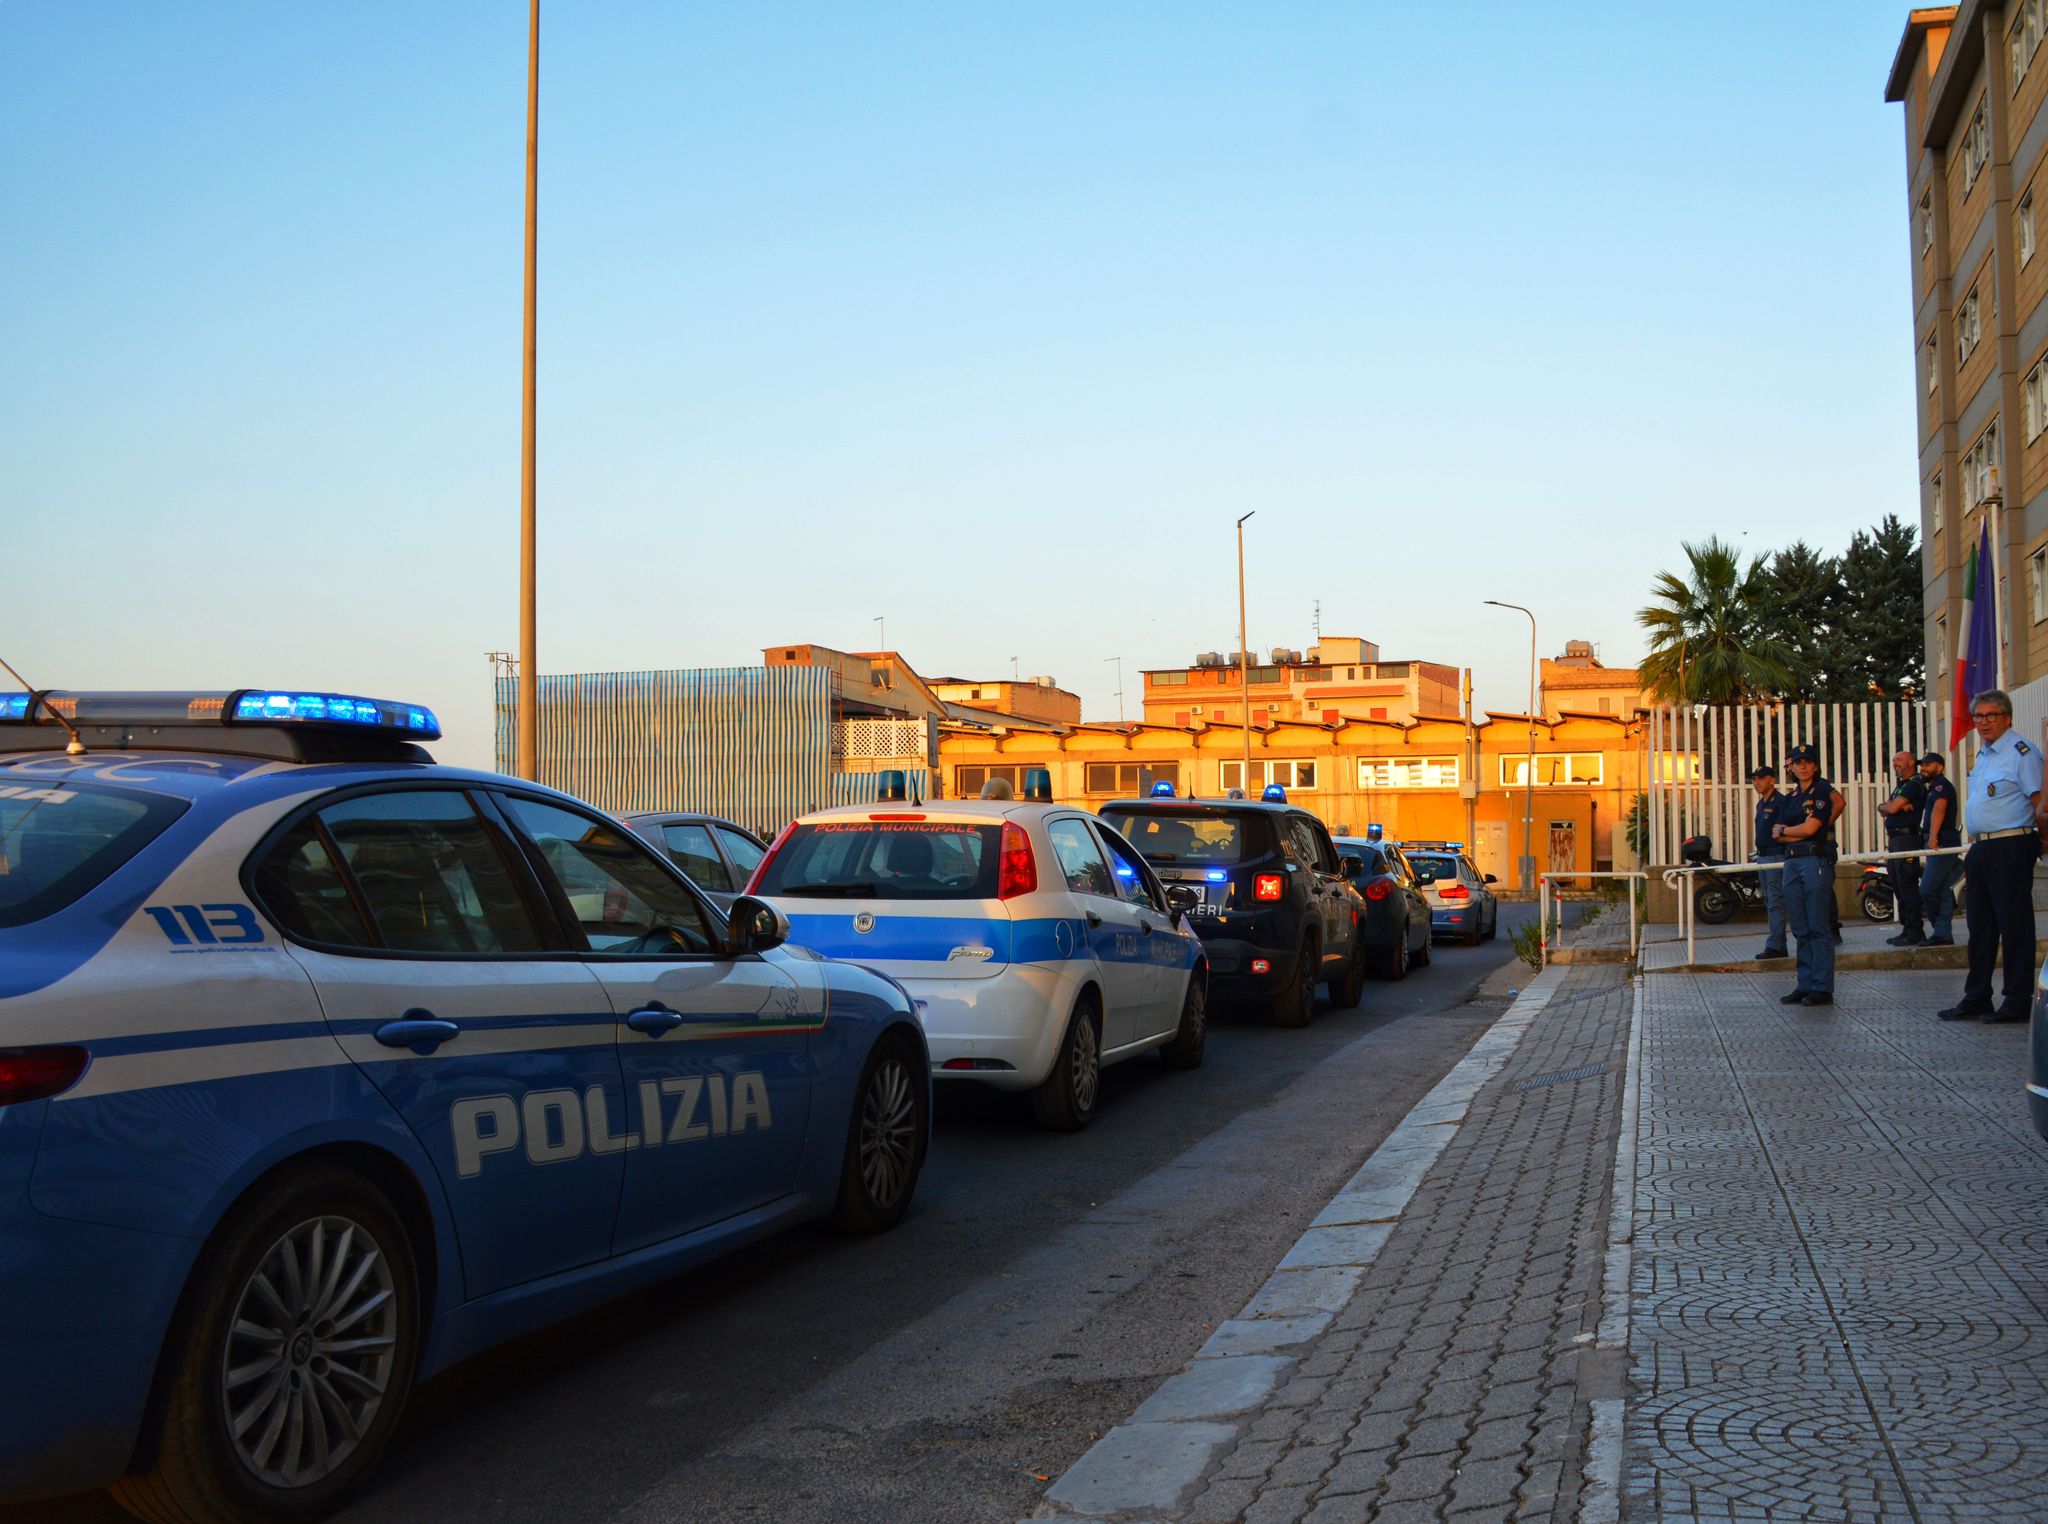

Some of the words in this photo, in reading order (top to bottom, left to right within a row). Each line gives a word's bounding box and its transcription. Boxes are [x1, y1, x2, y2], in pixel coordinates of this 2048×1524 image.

[0, 754, 223, 782] GC
[0, 786, 79, 804] IA
[815, 824, 874, 833] POLIZIA
[879, 823, 977, 833] MUNICIPALE
[1159, 868, 1182, 879] Jeep
[1186, 904, 1222, 916] IERI
[143, 903, 265, 945] 113
[1115, 933, 1138, 957] POLIZIA
[450, 1070, 773, 1179] POLIZIA
